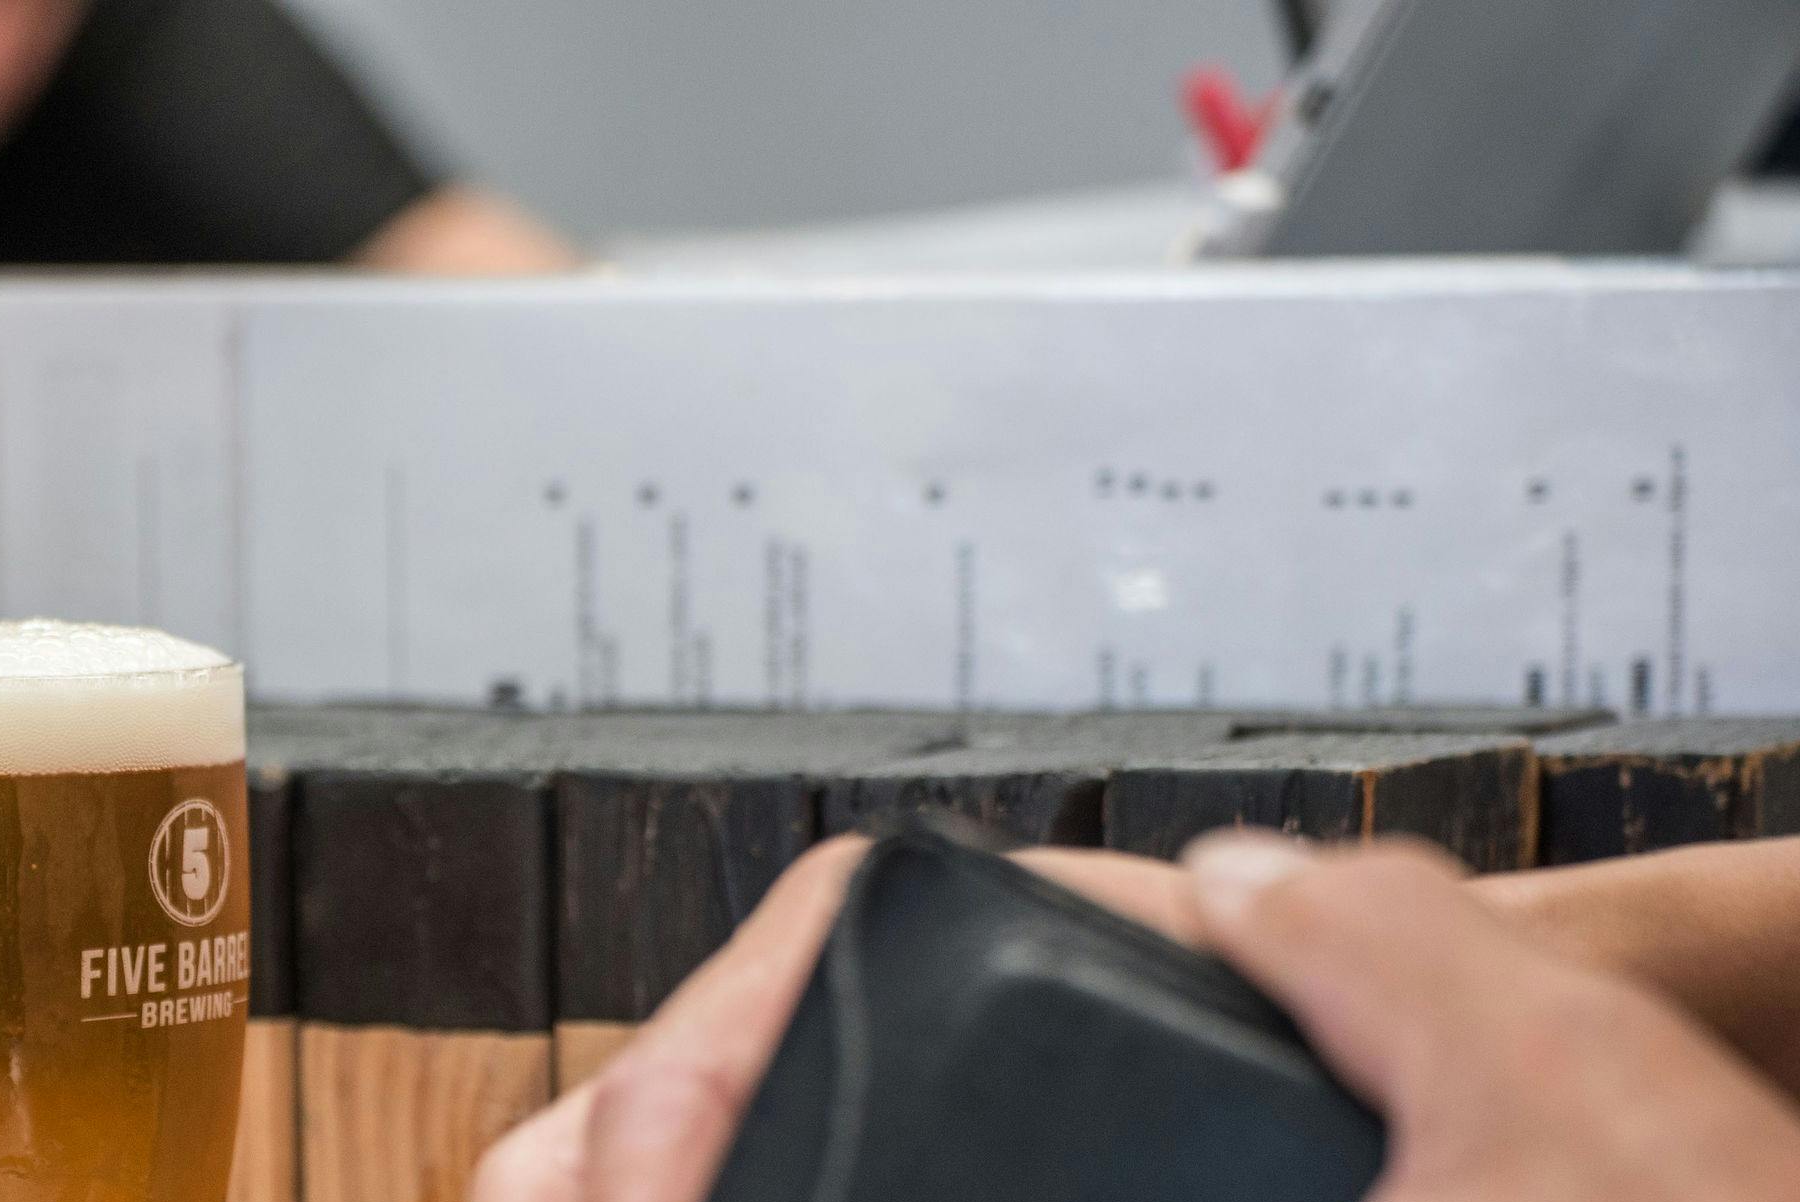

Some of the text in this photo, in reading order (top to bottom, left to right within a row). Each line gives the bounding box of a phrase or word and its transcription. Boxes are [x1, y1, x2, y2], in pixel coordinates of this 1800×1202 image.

[181, 827, 210, 901] 5
[80, 943, 166, 999] FIVE
[141, 990, 233, 1029] BREWING
